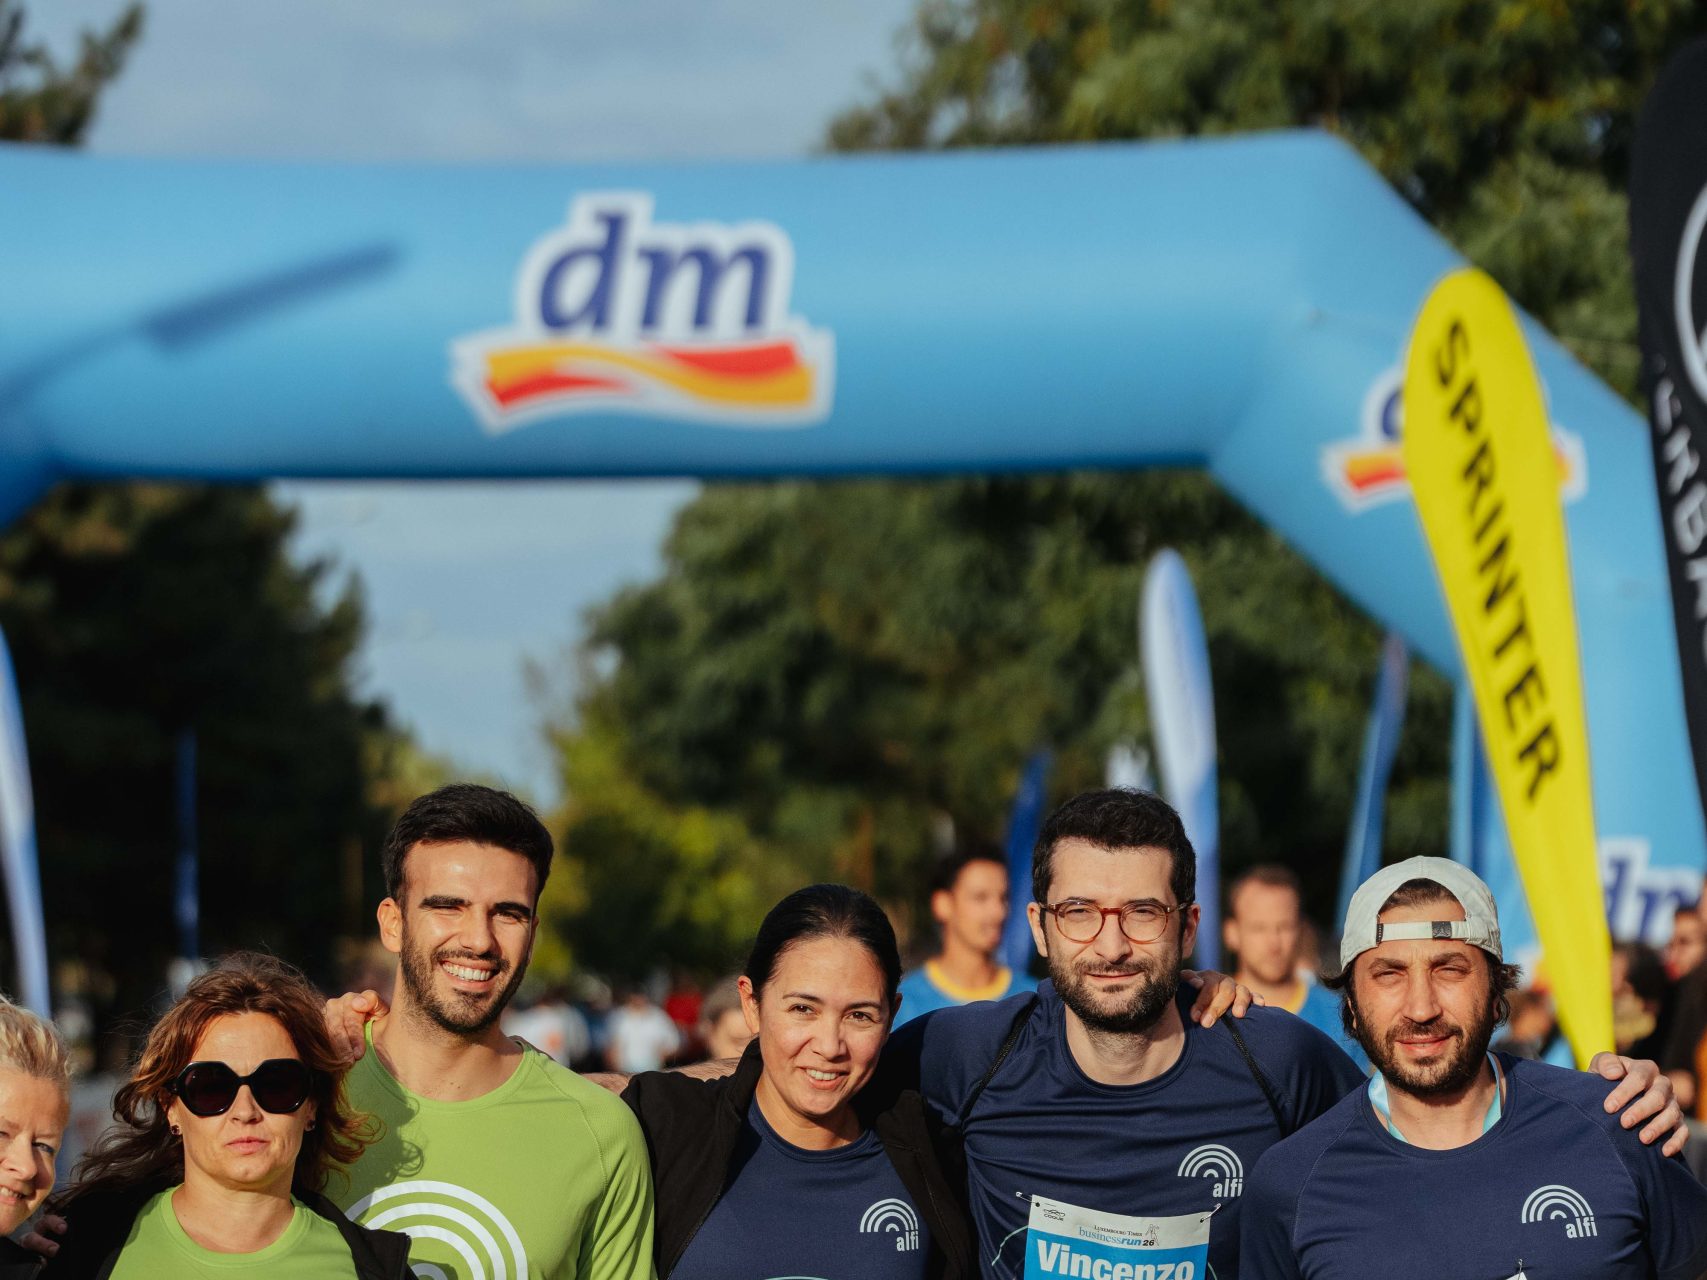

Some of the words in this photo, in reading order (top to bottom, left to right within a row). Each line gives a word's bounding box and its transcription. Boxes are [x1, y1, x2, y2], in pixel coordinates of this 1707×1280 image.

[540, 209, 772, 335] dm
[1431, 317, 1562, 803] SPRINTER
[1213, 1179, 1243, 1198] alfi
[1566, 1215, 1598, 1239] alfi
[896, 1230, 919, 1252] alfi
